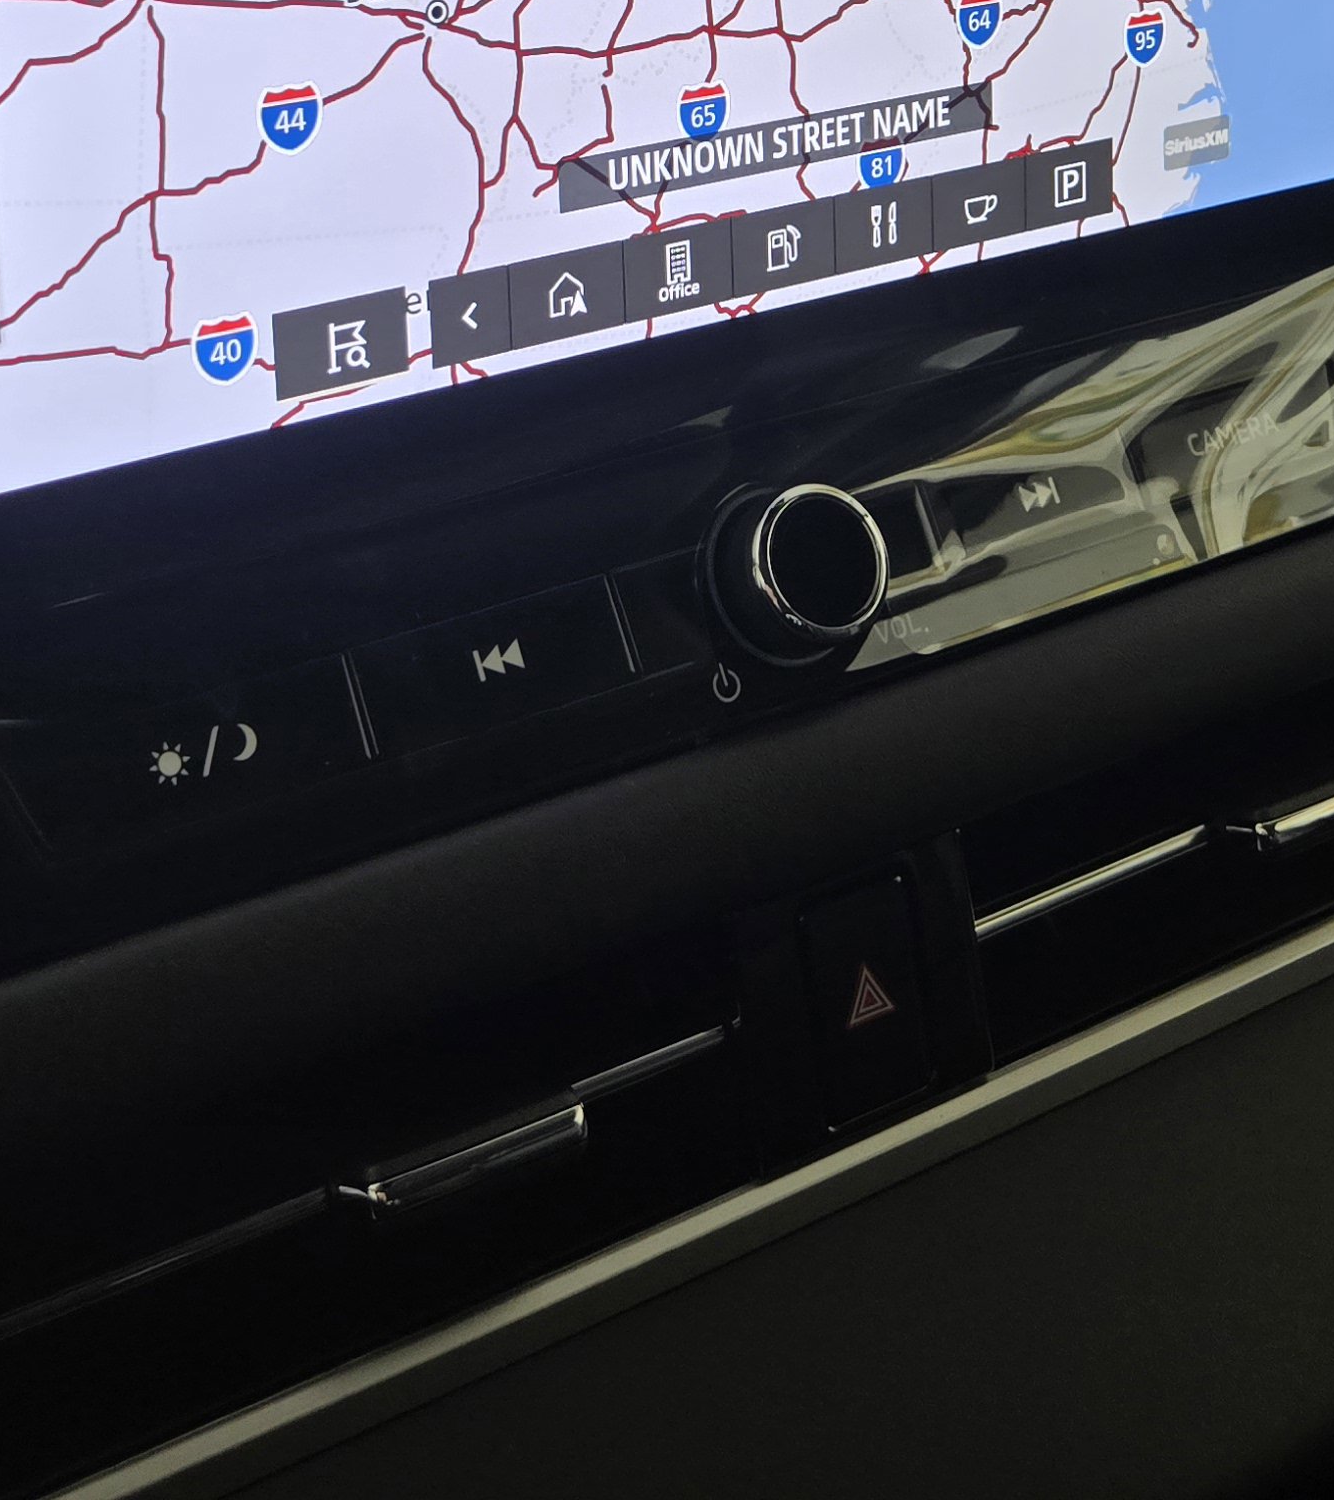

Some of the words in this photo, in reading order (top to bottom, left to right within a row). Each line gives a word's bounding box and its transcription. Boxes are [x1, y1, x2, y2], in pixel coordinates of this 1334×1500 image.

[967, 9, 991, 31] 64
[1135, 29, 1155, 50] 95
[276, 108, 306, 133] 44
[690, 103, 716, 127] 65
[608, 133, 764, 190] UNKNOWN
[772, 112, 864, 161] STREET
[872, 96, 950, 138] NAME
[1165, 128, 1228, 156] SiriusXM
[871, 155, 892, 178] 81
[659, 279, 700, 302] Office
[211, 339, 241, 364] 40
[1186, 411, 1280, 457] CAMERA
[874, 616, 930, 643] VOL.
